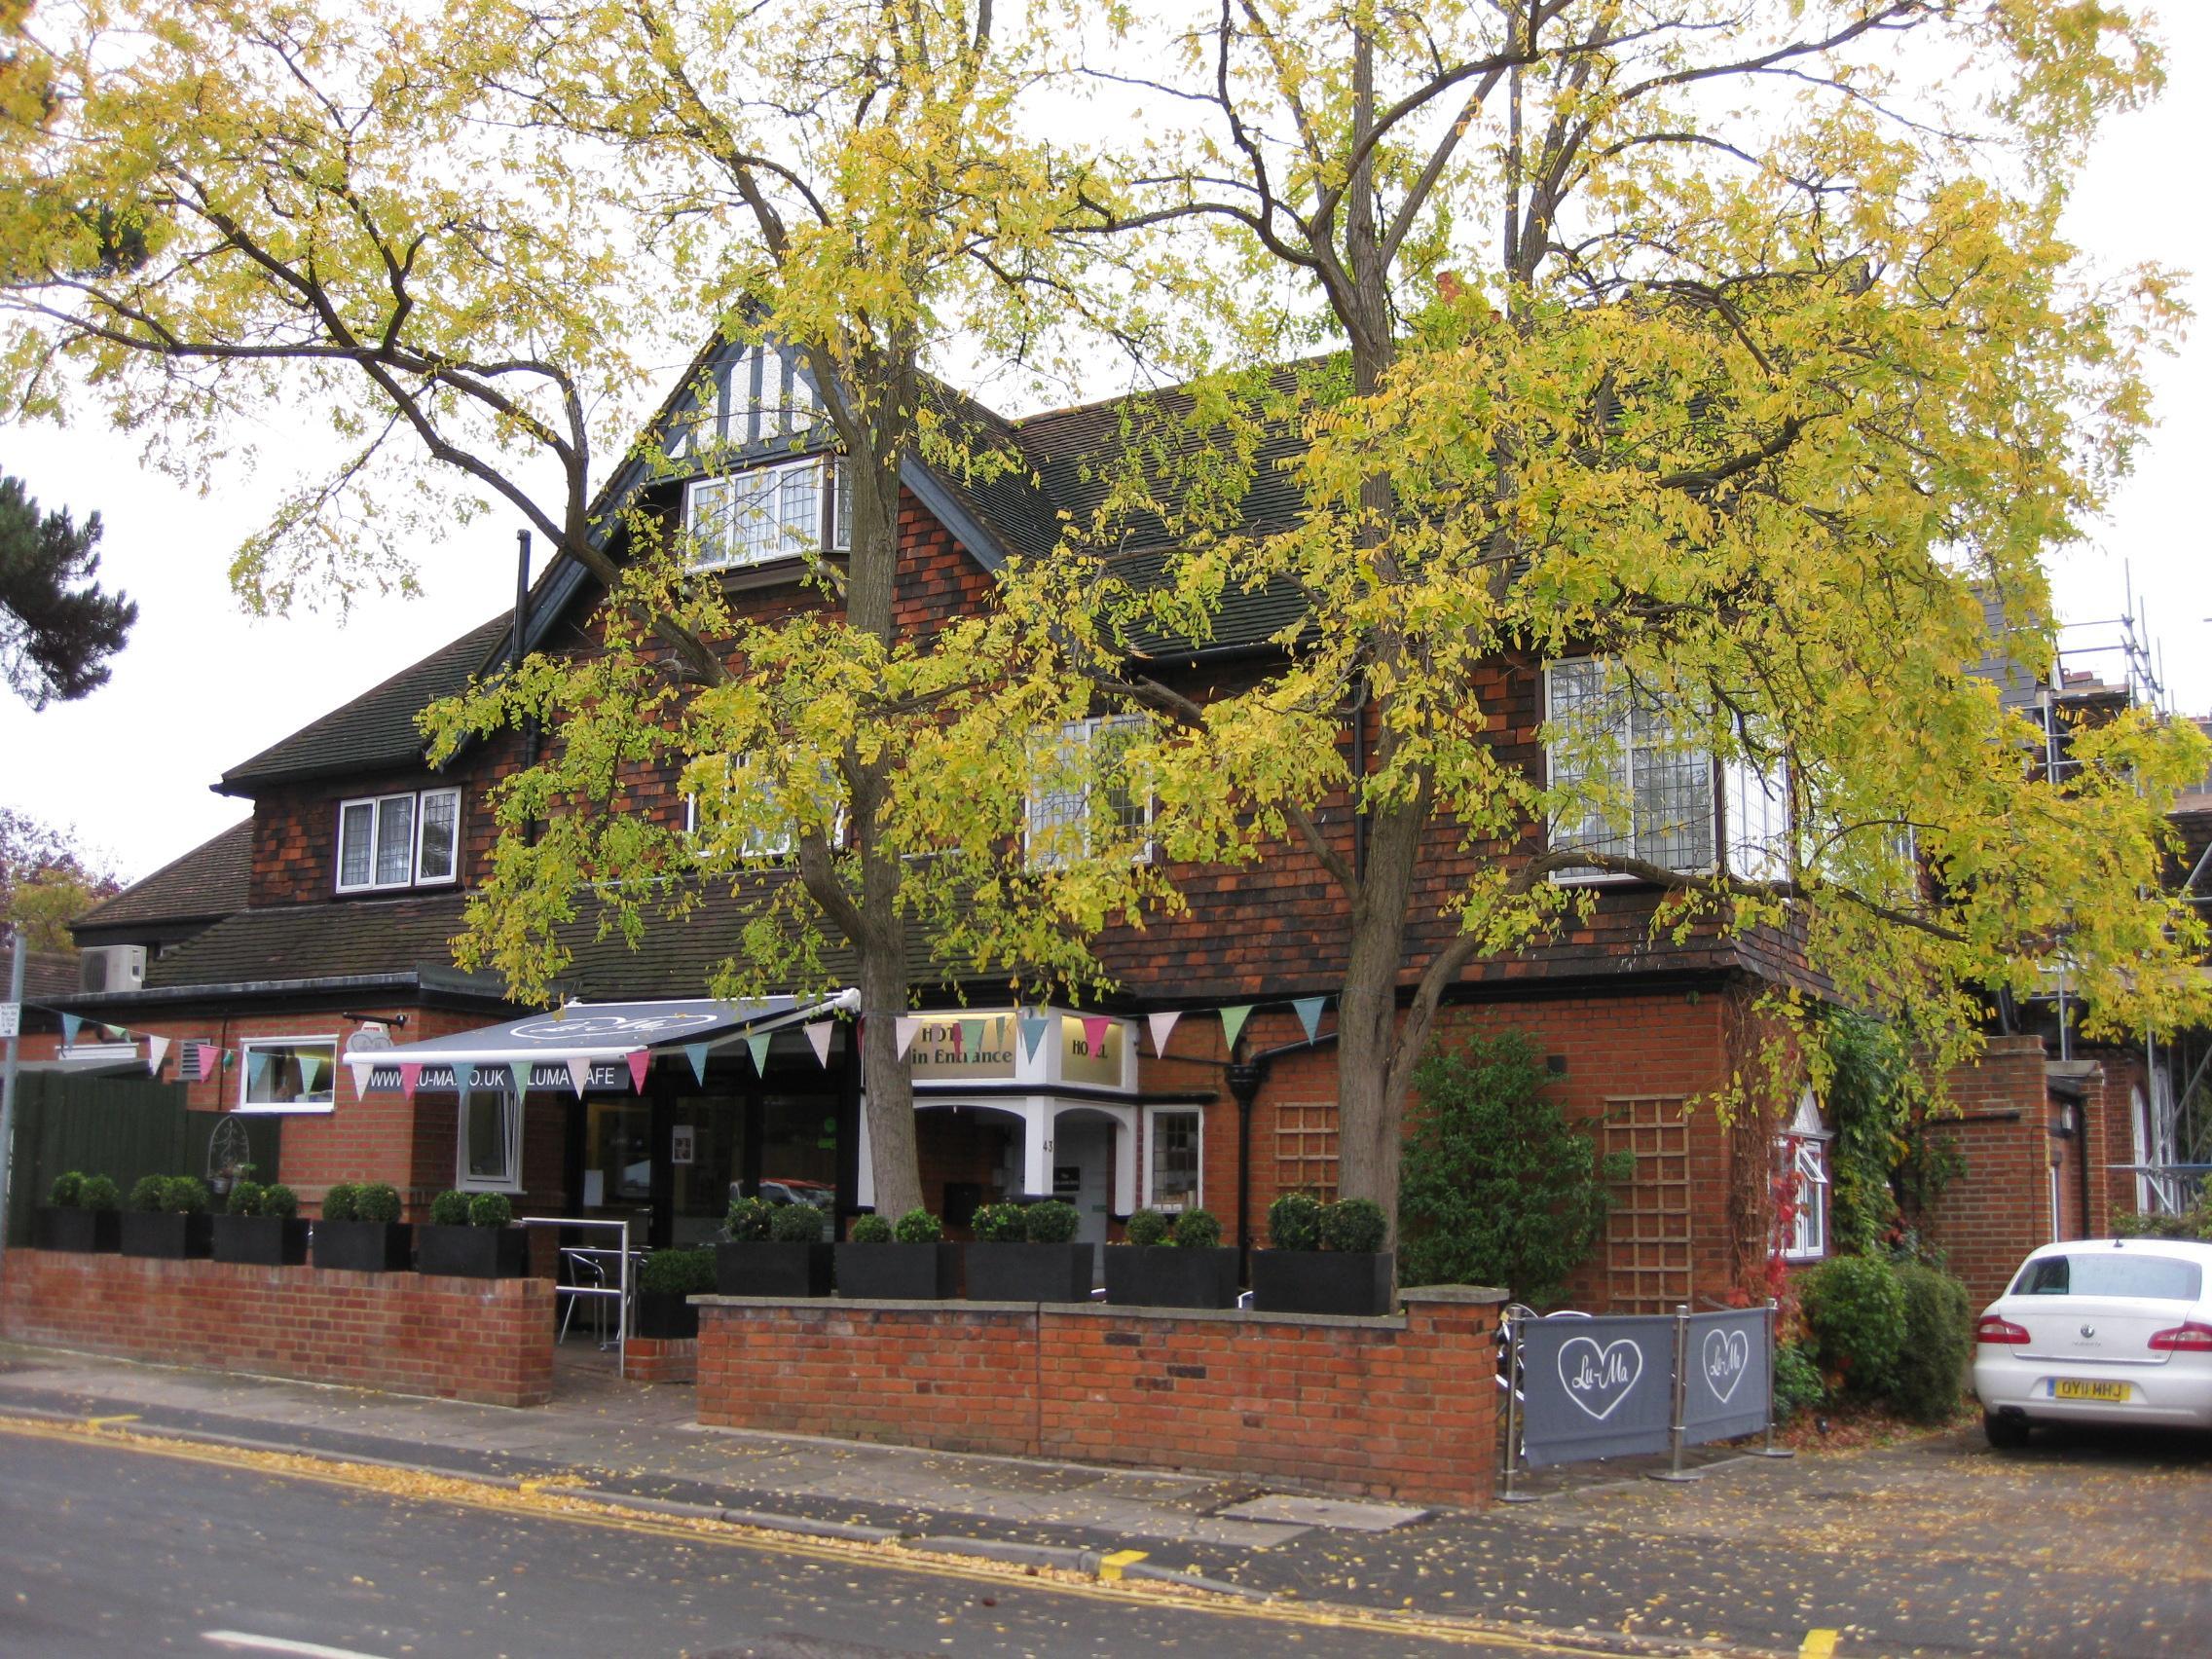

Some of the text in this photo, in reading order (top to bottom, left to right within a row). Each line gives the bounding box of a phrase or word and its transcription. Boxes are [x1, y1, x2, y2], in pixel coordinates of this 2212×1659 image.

[922, 1026, 962, 1042] HOT
[580, 1067, 614, 1085] AFE
[1043, 1140, 1053, 1153] 43
